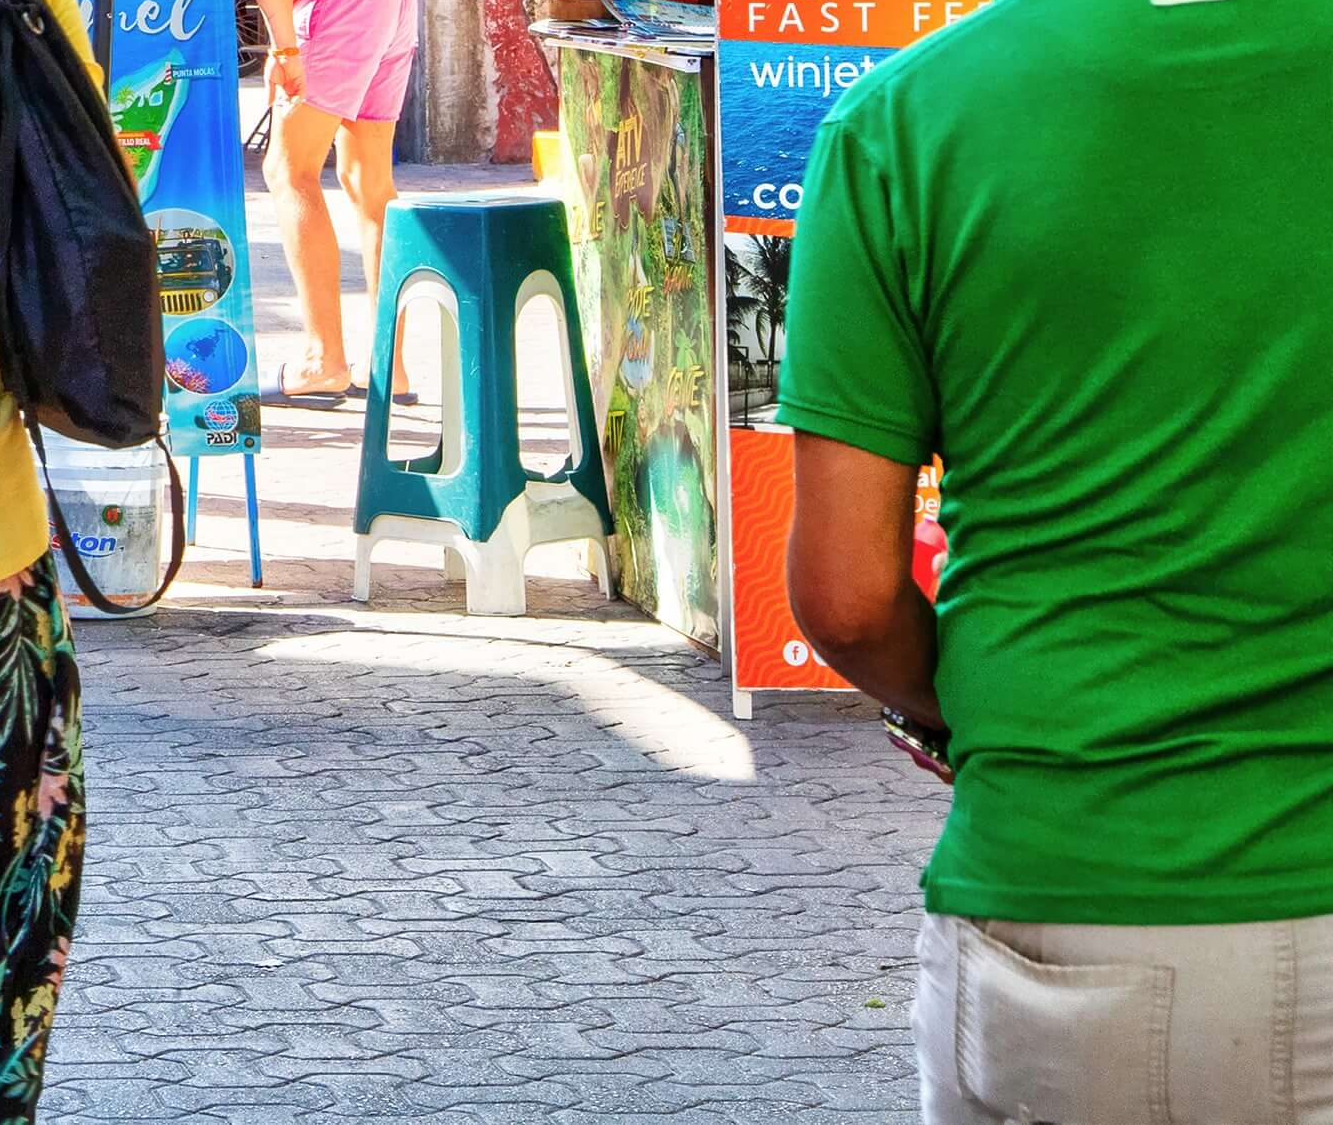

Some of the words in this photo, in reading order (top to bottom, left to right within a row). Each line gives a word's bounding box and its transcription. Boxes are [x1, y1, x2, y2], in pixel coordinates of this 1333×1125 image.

[747, 2, 876, 33] FAST
[615, 115, 643, 170] ATV
[206, 431, 238, 445] PADI
